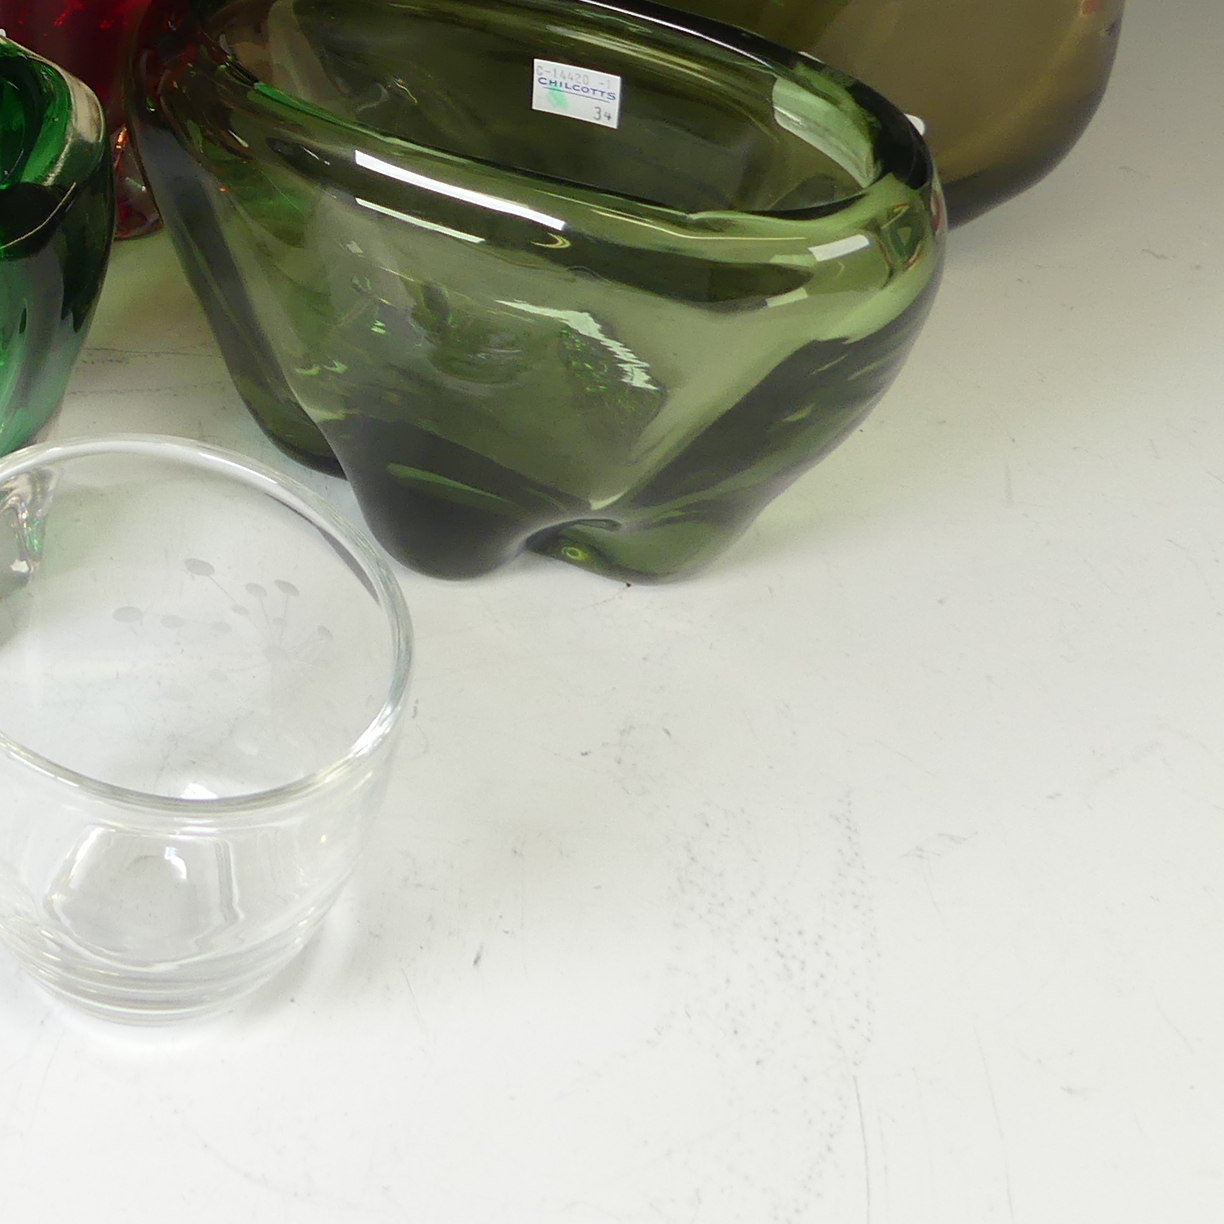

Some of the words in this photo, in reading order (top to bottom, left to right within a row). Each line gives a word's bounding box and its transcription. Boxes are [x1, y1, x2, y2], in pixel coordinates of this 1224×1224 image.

[536, 65, 589, 85] C-14420
[537, 77, 616, 101] CHILCOTTS
[593, 106, 612, 121] 34
